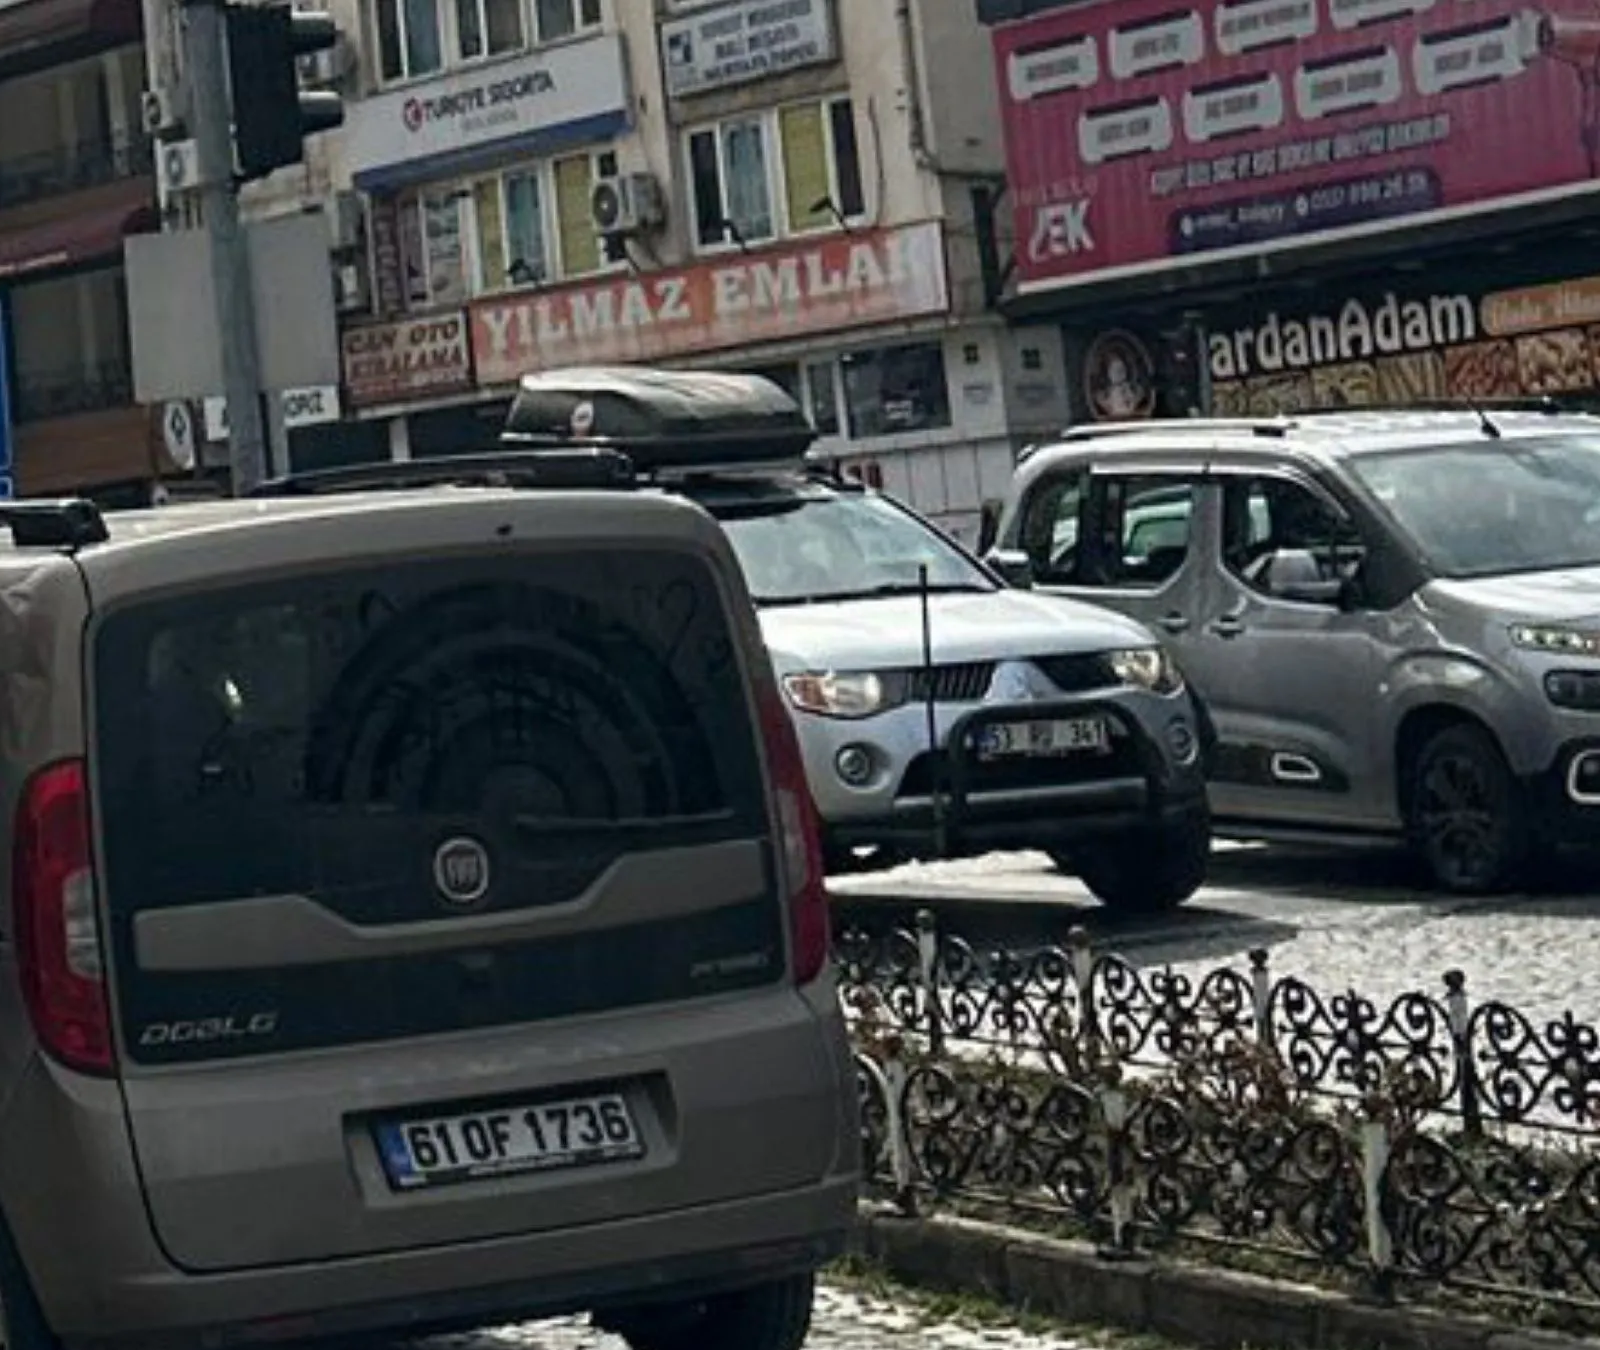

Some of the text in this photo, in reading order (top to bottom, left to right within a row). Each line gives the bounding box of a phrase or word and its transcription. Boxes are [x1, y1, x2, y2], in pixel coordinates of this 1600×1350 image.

[482, 275, 690, 354] YILMAZ
[407, 1124, 458, 1168] 61
[462, 1115, 510, 1160] OF
[523, 1100, 631, 1152] 1736
